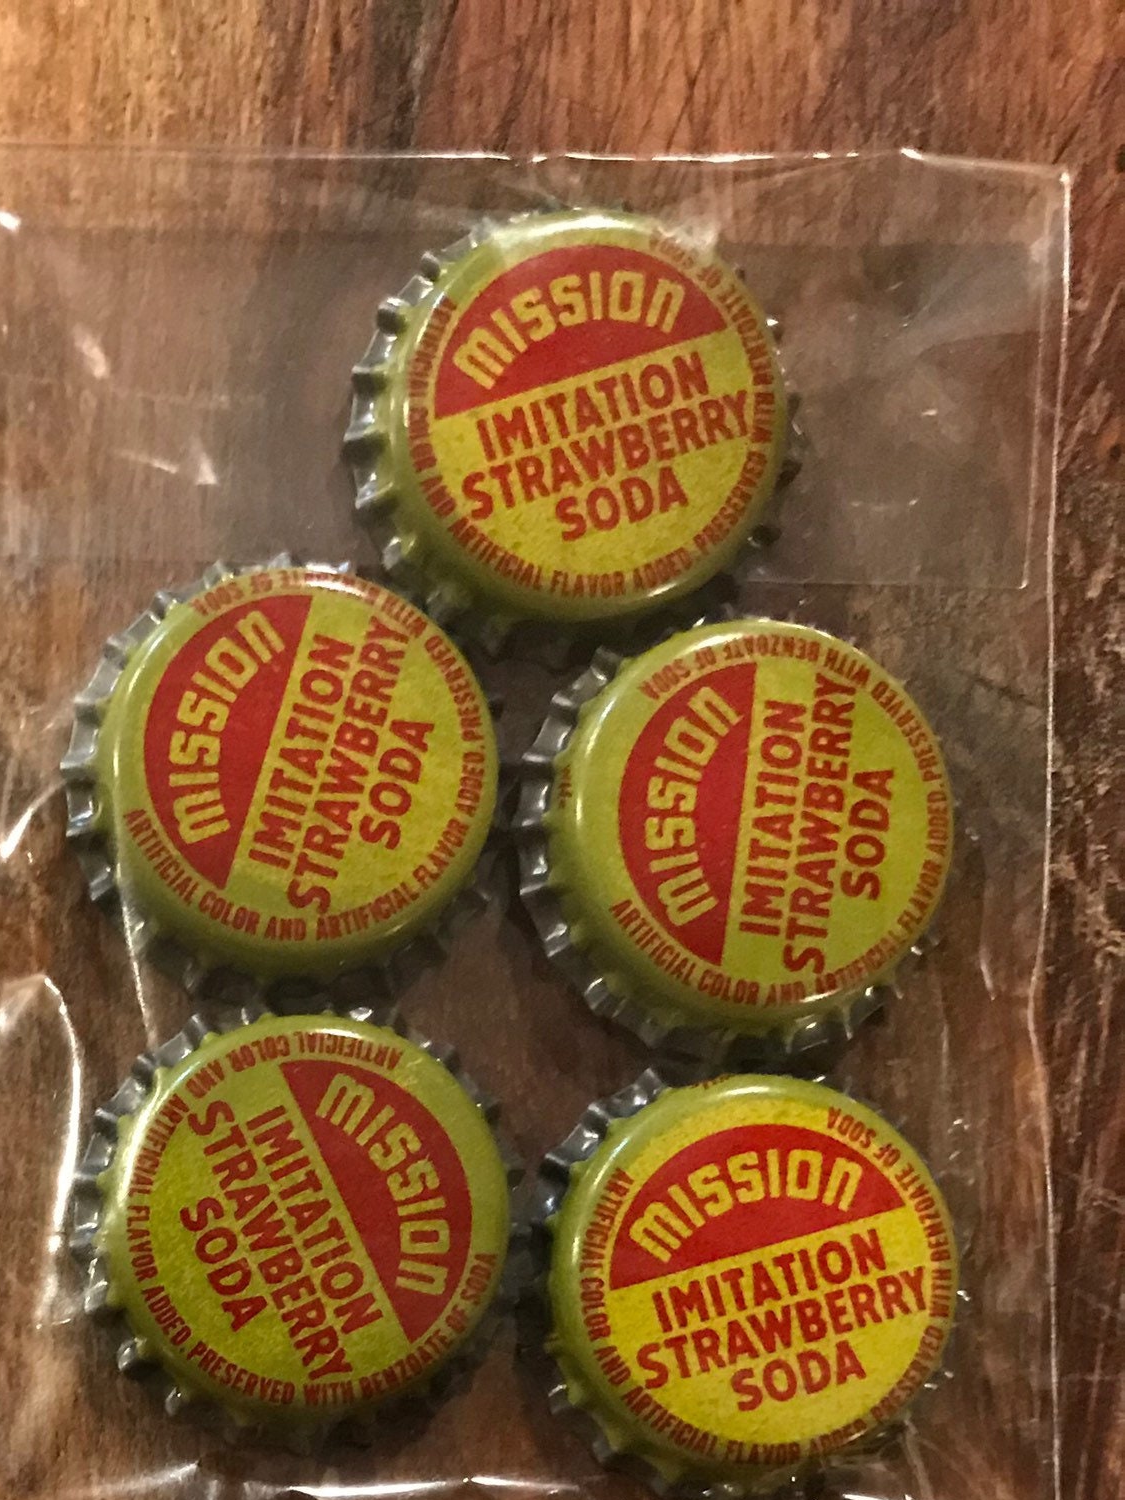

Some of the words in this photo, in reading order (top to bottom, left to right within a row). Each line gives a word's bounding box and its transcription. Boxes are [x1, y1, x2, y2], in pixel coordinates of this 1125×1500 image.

[452, 270, 686, 390] MISSION
[477, 351, 710, 461] IMITATION
[419, 475, 458, 518] AND
[446, 516, 545, 587] ARTIFICIAL
[551, 571, 624, 595] FLAVOR
[691, 450, 769, 554] PRESERVED
[751, 392, 773, 444] WITH
[461, 390, 752, 521] STRAWBERRY
[555, 467, 689, 542] SODA
[380, 596, 428, 636] WITH
[722, 638, 822, 662] BENZOATE
[422, 633, 482, 739] PRESERVED
[822, 649, 873, 685] WITH
[169, 610, 285, 845] MISSION
[248, 634, 355, 870] IMITATION
[286, 615, 409, 914] STRAWBERRY
[870, 680, 939, 780] PRESERVED
[358, 718, 435, 850] SODA
[645, 686, 743, 926] MISSION
[738, 701, 807, 936] IMITATION
[782, 673, 856, 973] STRAWBERRY
[124, 808, 201, 905] ARTIFICIAL
[412, 819, 470, 889] FLAVOR
[840, 768, 895, 901] SODA
[197, 890, 259, 934] COLOR
[265, 916, 304, 939] AND
[316, 879, 419, 936] ARTIFICIAL
[609, 897, 696, 985] ARTIFICIAL
[896, 859, 941, 933] FLAVOR
[697, 969, 757, 1002] COLOR
[186, 1060, 225, 1099] AND
[226, 1035, 288, 1072] COLOR
[295, 1032, 402, 1071] ARTIFICIAL
[130, 1094, 190, 1195] ARTIFICIAL
[823, 1107, 877, 1148] SODA
[873, 1142, 901, 1167] OF
[246, 1105, 384, 1335] IMITATION
[315, 1073, 450, 1295] MISSION
[581, 1168, 634, 1271] ARTIFICIAL
[628, 1149, 864, 1264] MISSION
[894, 1164, 949, 1260] BENZOATE
[127, 1206, 158, 1281] FLAVOR
[180, 1195, 268, 1332] SODA
[188, 1100, 353, 1380] STRAWBERRY
[459, 1251, 495, 1305] SODA
[652, 1228, 886, 1333] IMITATION
[581, 1278, 612, 1342] COLOR
[637, 1266, 927, 1390] STRAWBERRY
[929, 1269, 950, 1319] WITH
[187, 1341, 293, 1403] PRESERVED
[305, 1382, 354, 1405] WITH
[594, 1343, 631, 1388] AND
[730, 1339, 867, 1412] SODA
[621, 1383, 718, 1457] ARTIFICIAL
